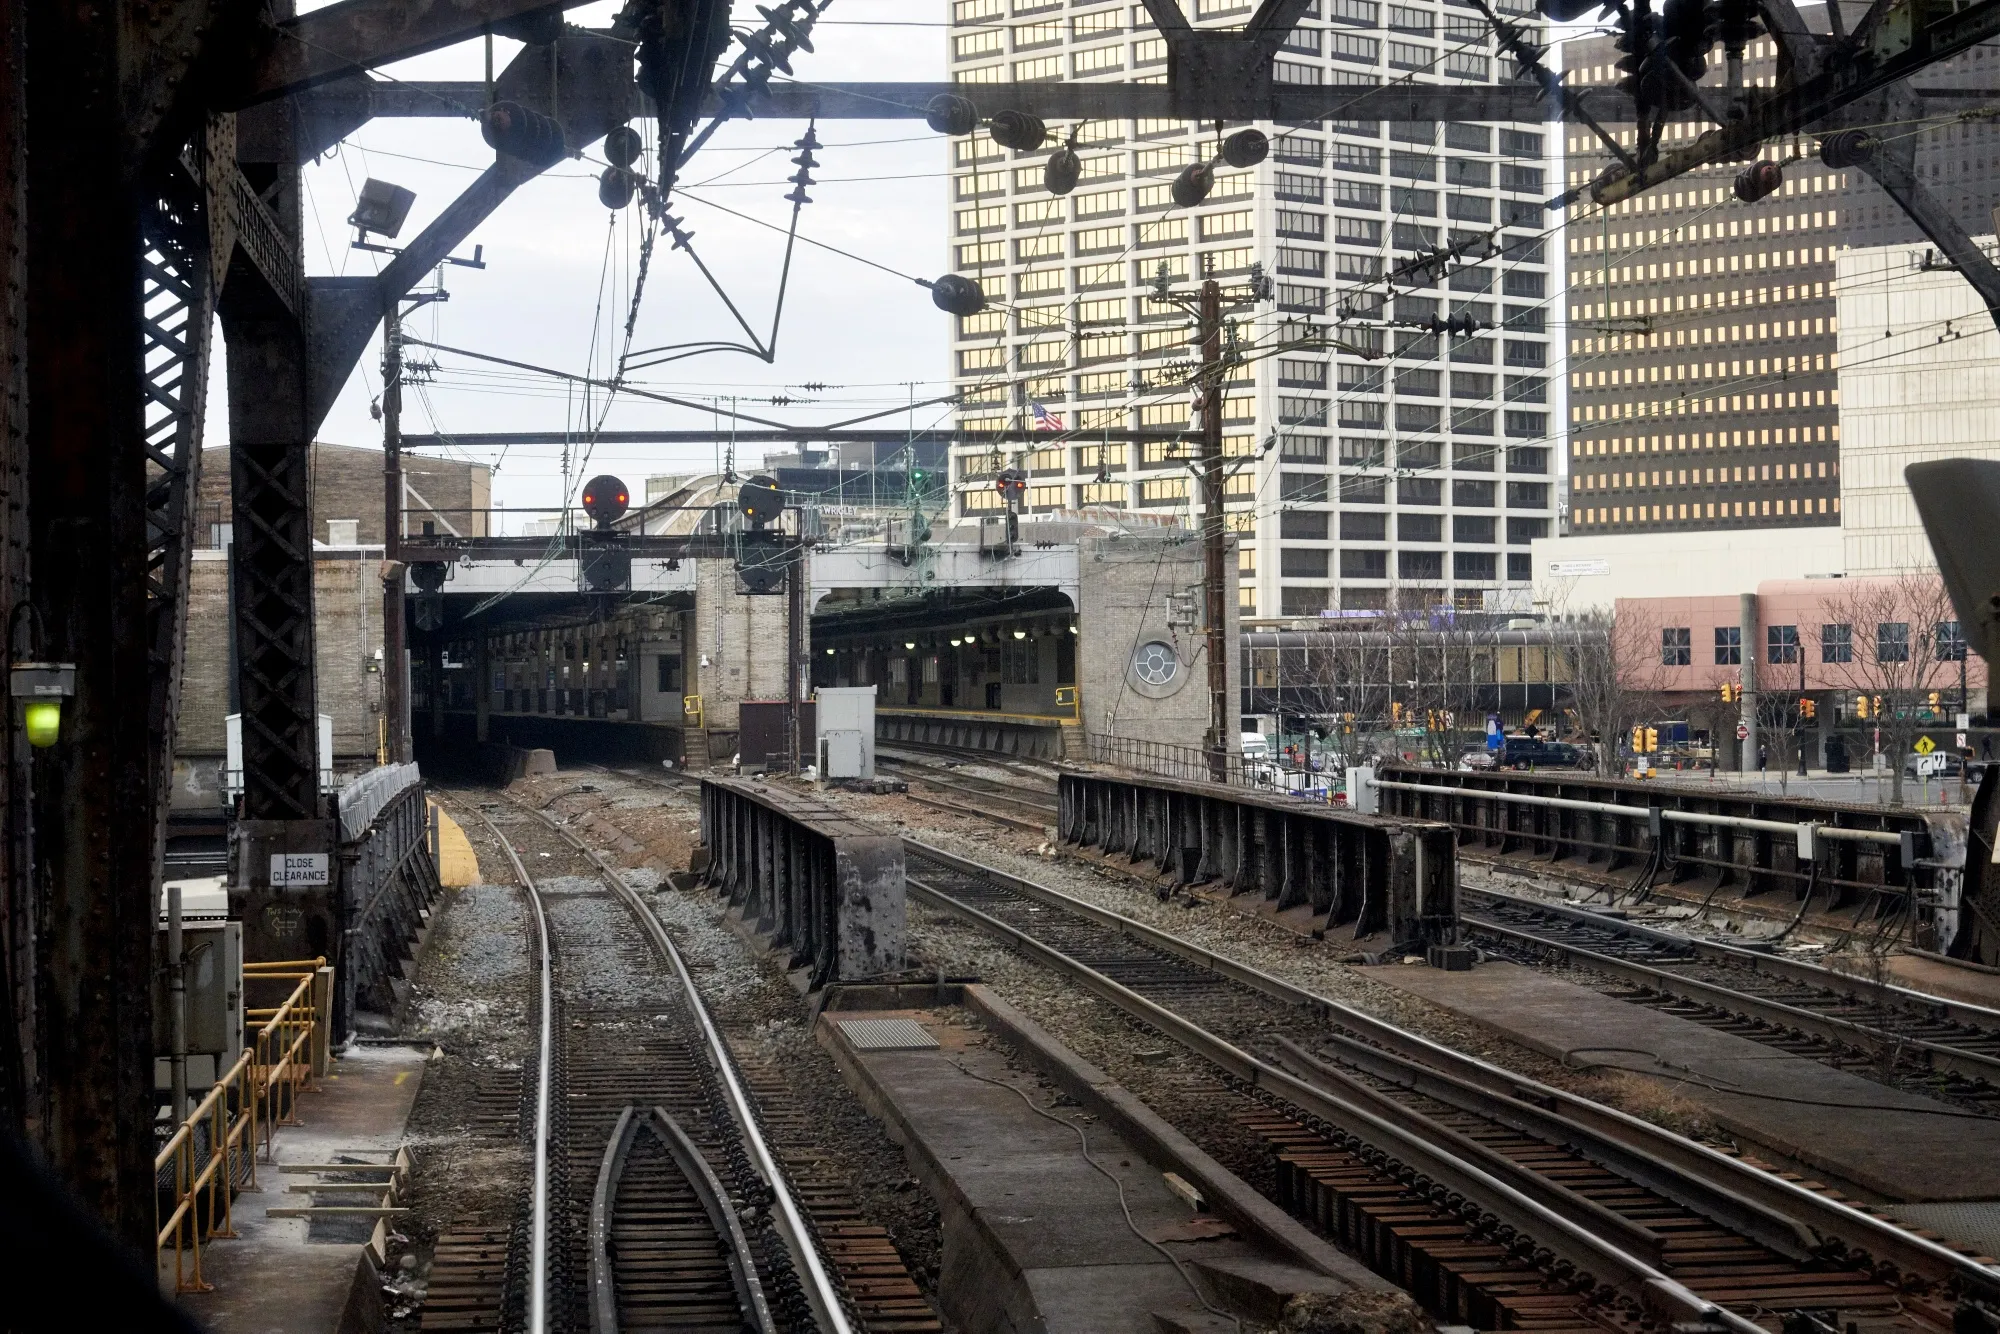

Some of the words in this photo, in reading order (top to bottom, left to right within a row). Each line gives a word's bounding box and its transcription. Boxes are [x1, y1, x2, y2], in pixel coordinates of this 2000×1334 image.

[823, 505, 858, 515] WRIGLEY
[285, 858, 314, 868] CLOSE
[273, 871, 326, 881] CLEARANCE
